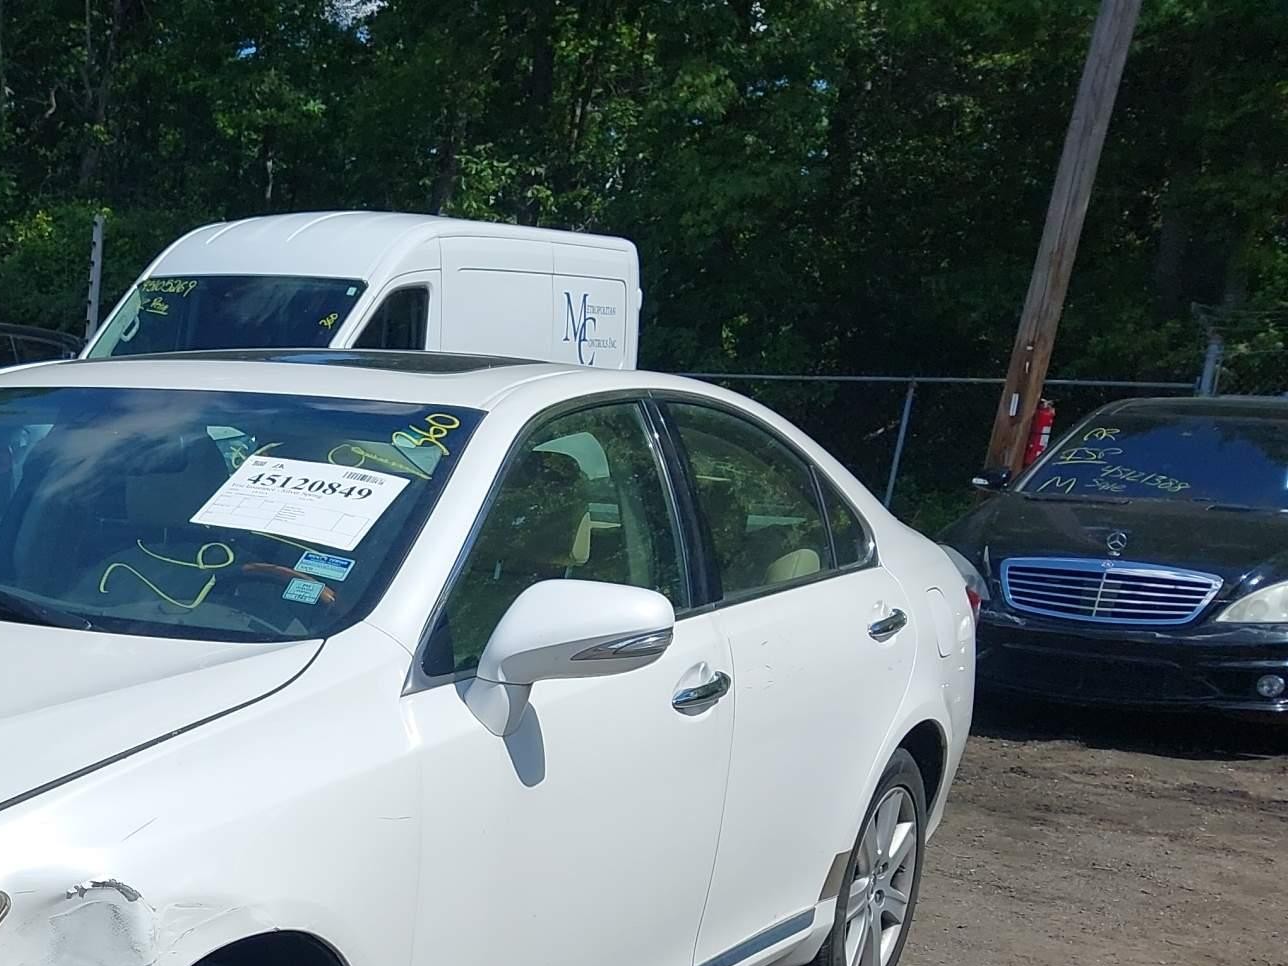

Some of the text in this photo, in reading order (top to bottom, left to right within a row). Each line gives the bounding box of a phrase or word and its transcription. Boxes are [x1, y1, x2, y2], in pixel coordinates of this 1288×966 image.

[392, 413, 460, 456] 360
[247, 472, 373, 500] 45120849
[1036, 476, 1077, 494] M
[100, 542, 234, 609] 26
